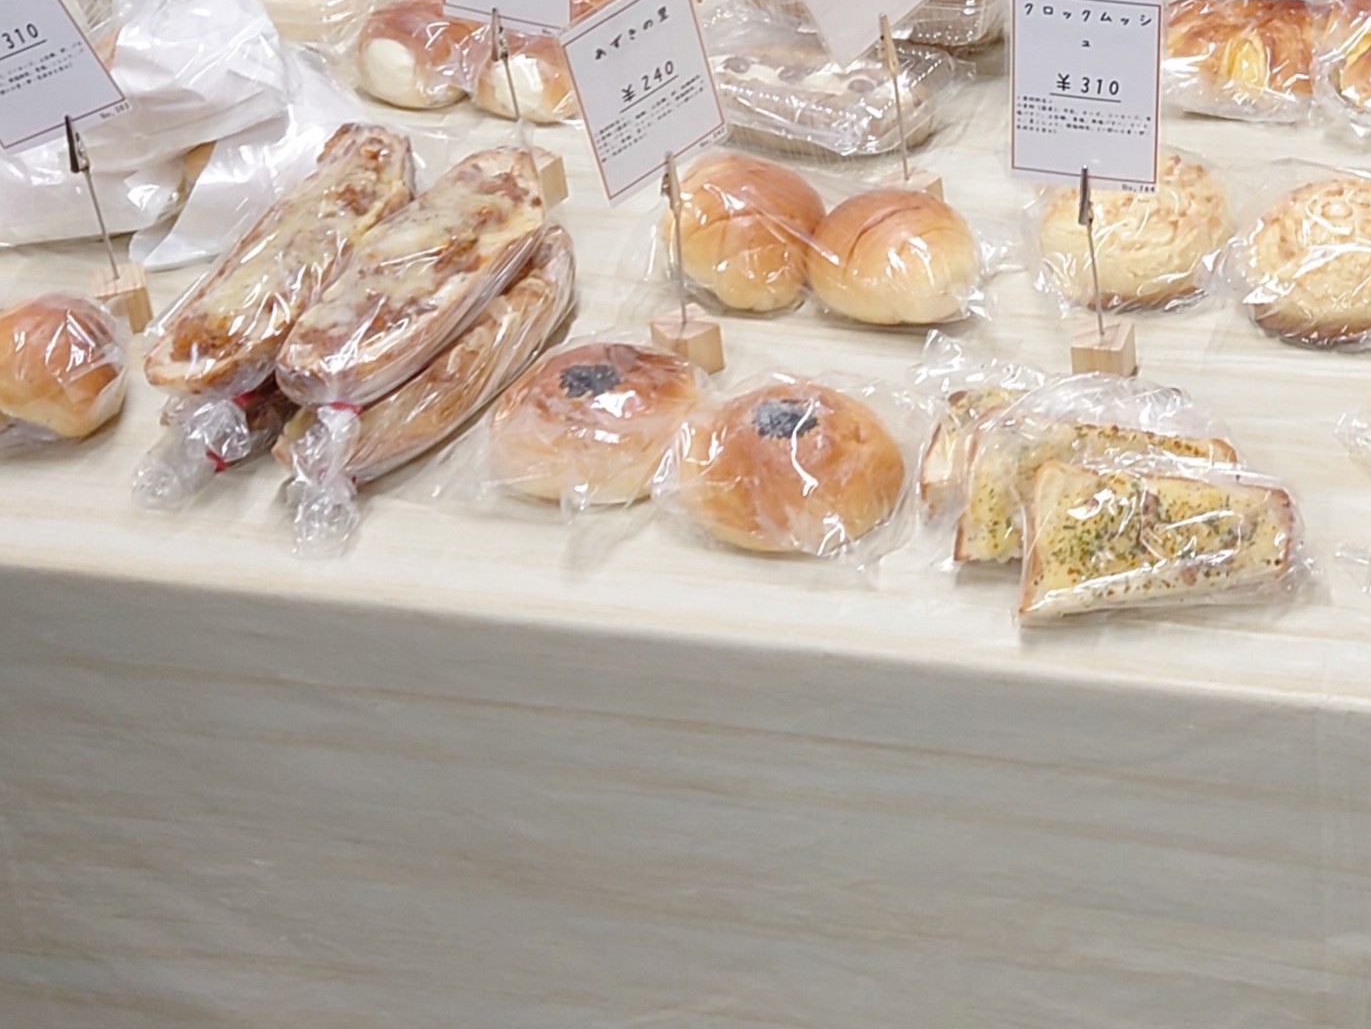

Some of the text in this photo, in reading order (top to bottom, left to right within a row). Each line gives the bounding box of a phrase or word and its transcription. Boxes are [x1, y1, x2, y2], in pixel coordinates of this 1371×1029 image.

[1023, 2, 1153, 27] クロックムッシ
[621, 60, 675, 104] ¥240
[1056, 73, 1120, 96] ¥310
